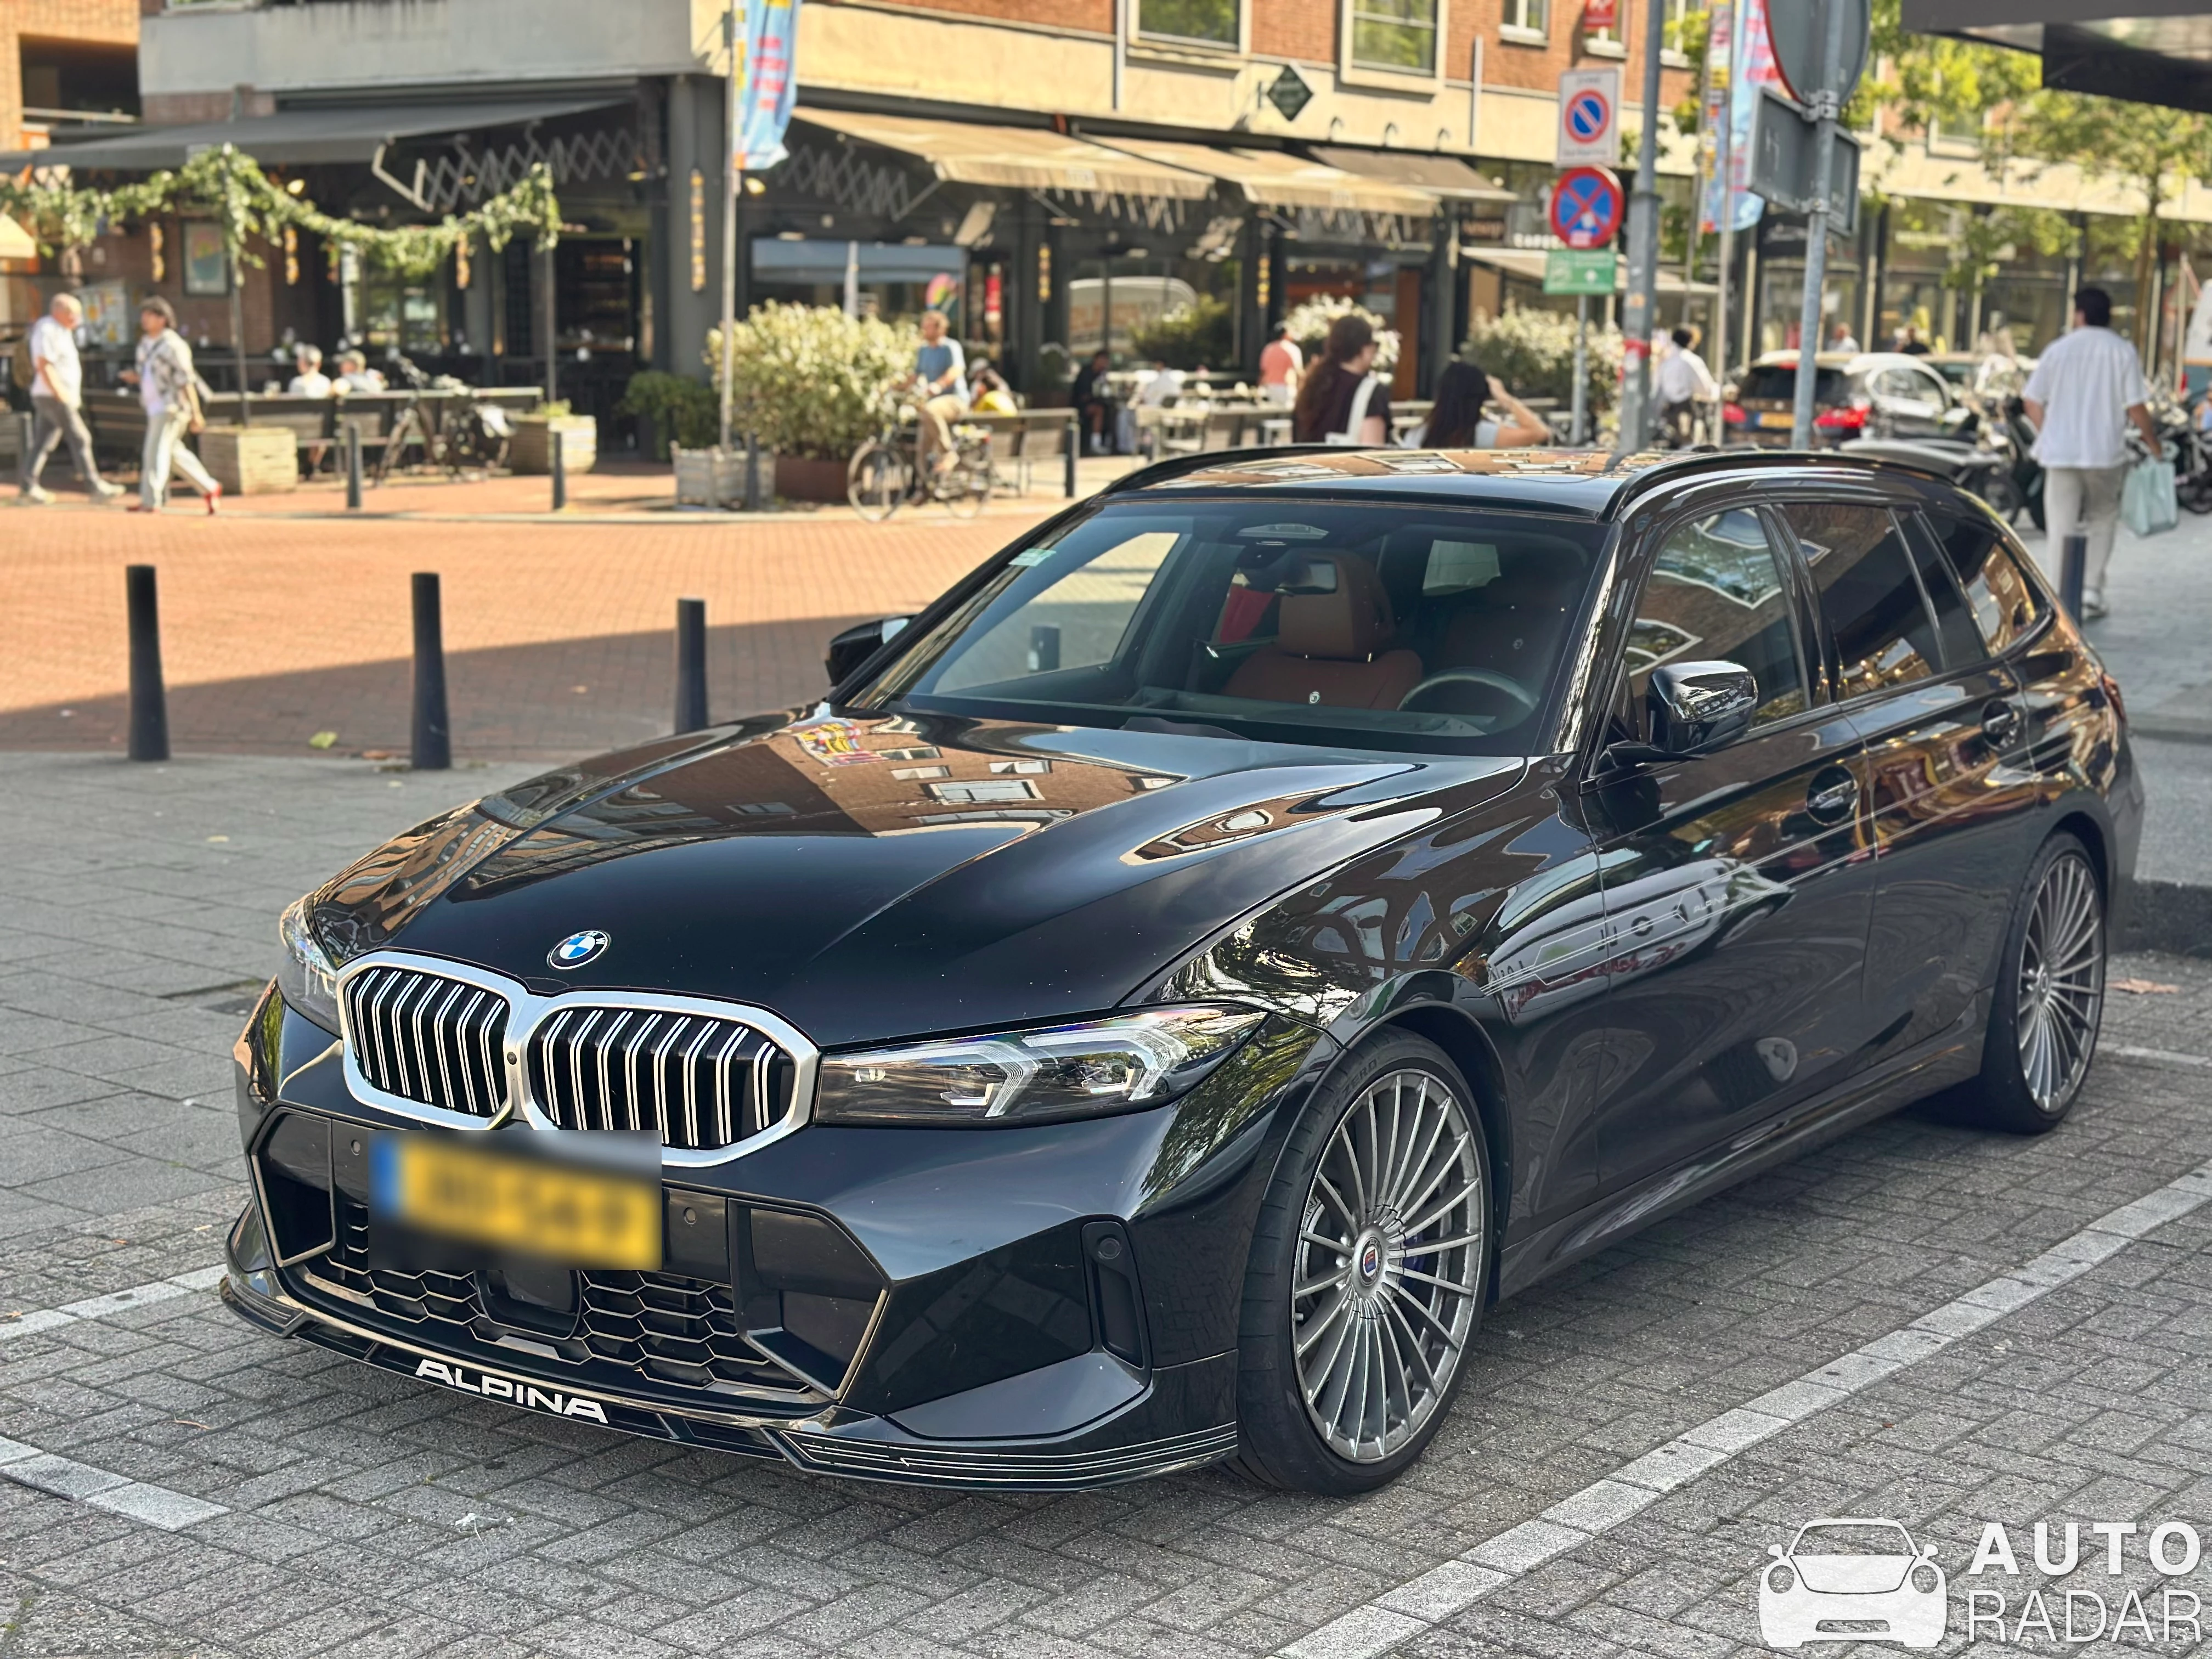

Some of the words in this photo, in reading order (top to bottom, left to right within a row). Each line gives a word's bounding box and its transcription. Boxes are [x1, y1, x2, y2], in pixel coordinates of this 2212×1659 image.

[1694, 893, 1729, 913] ALPINA
[1342, 1059, 1378, 1101] ZERO
[415, 1358, 608, 1424] ALPINA
